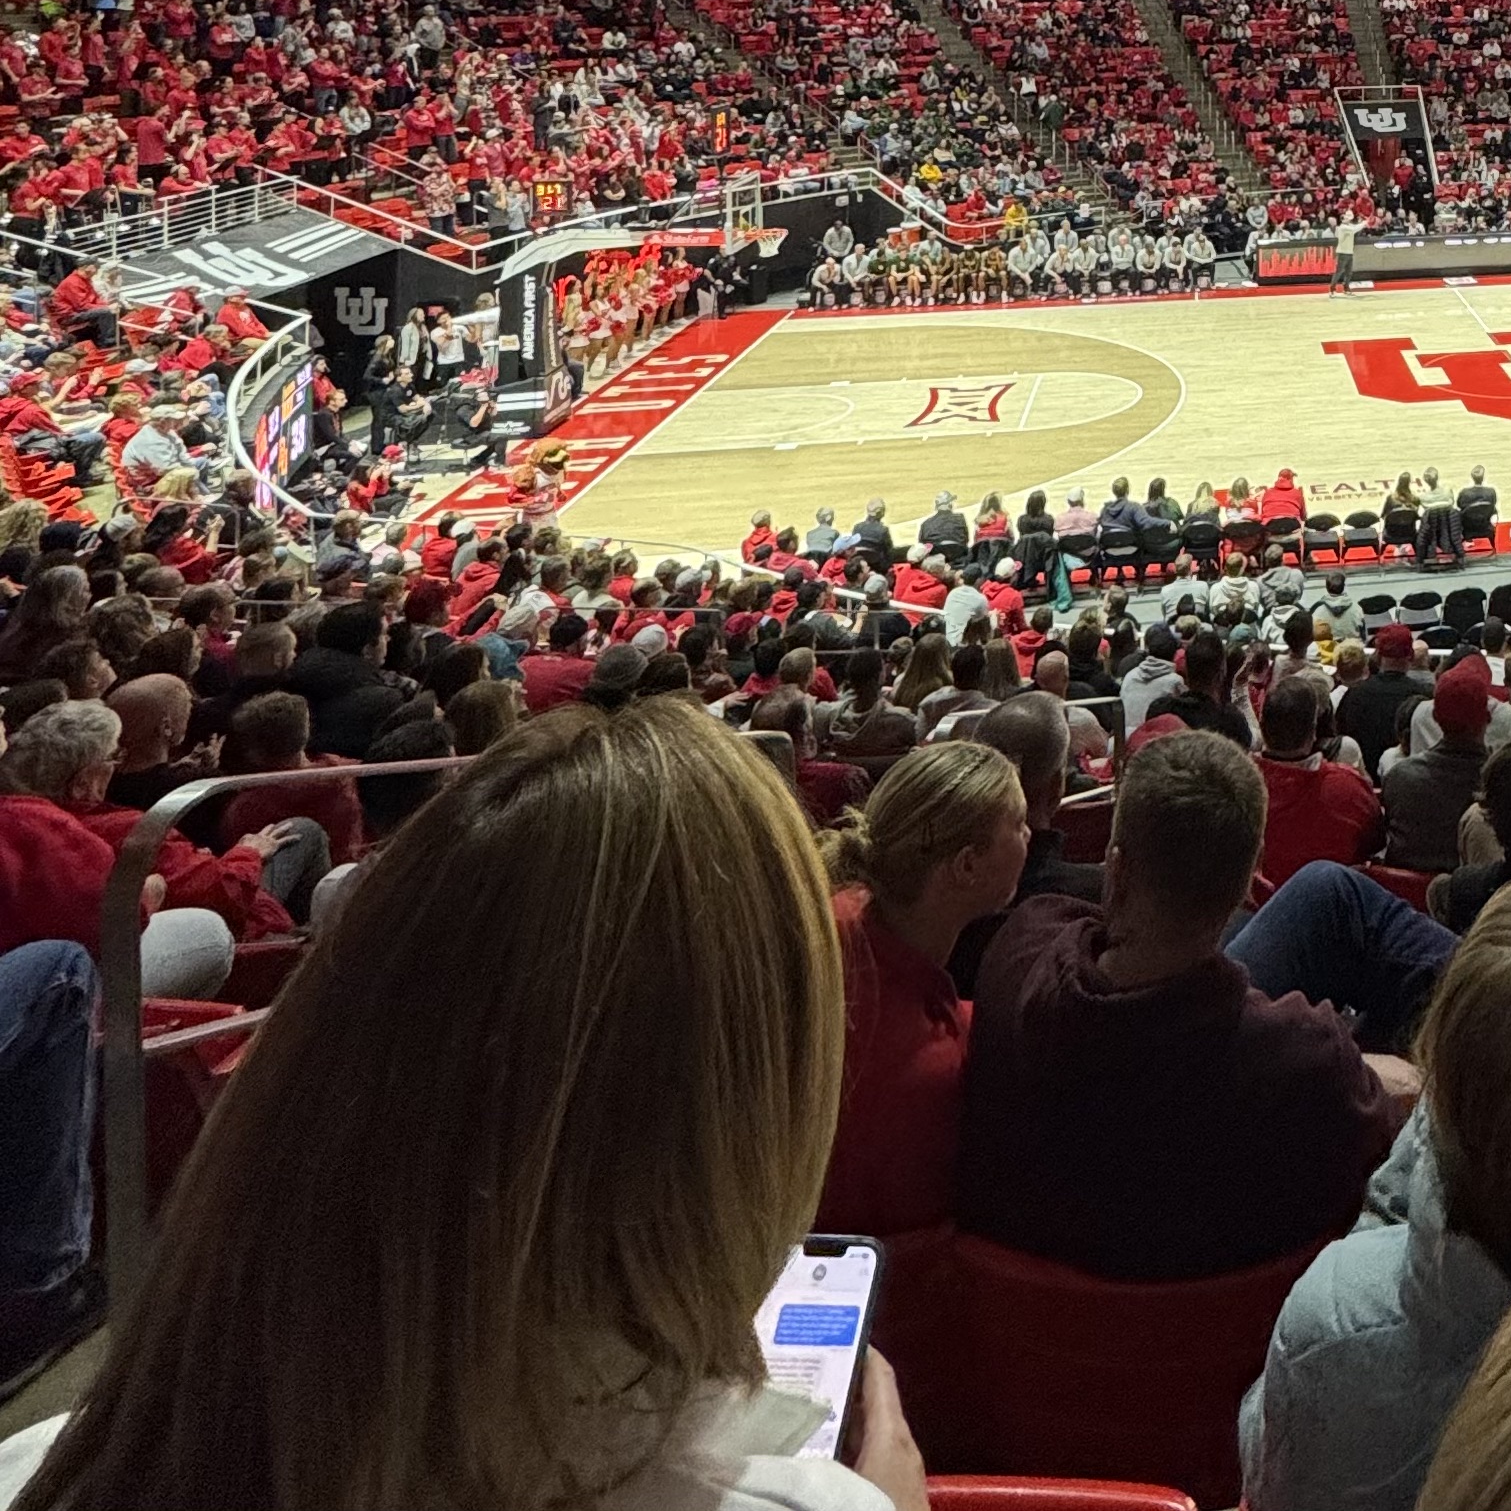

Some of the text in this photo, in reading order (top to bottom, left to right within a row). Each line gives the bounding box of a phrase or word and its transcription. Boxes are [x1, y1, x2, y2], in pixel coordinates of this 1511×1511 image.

[522, 274, 536, 360] AMERICA FIRST
[574, 354, 730, 416] UTES
